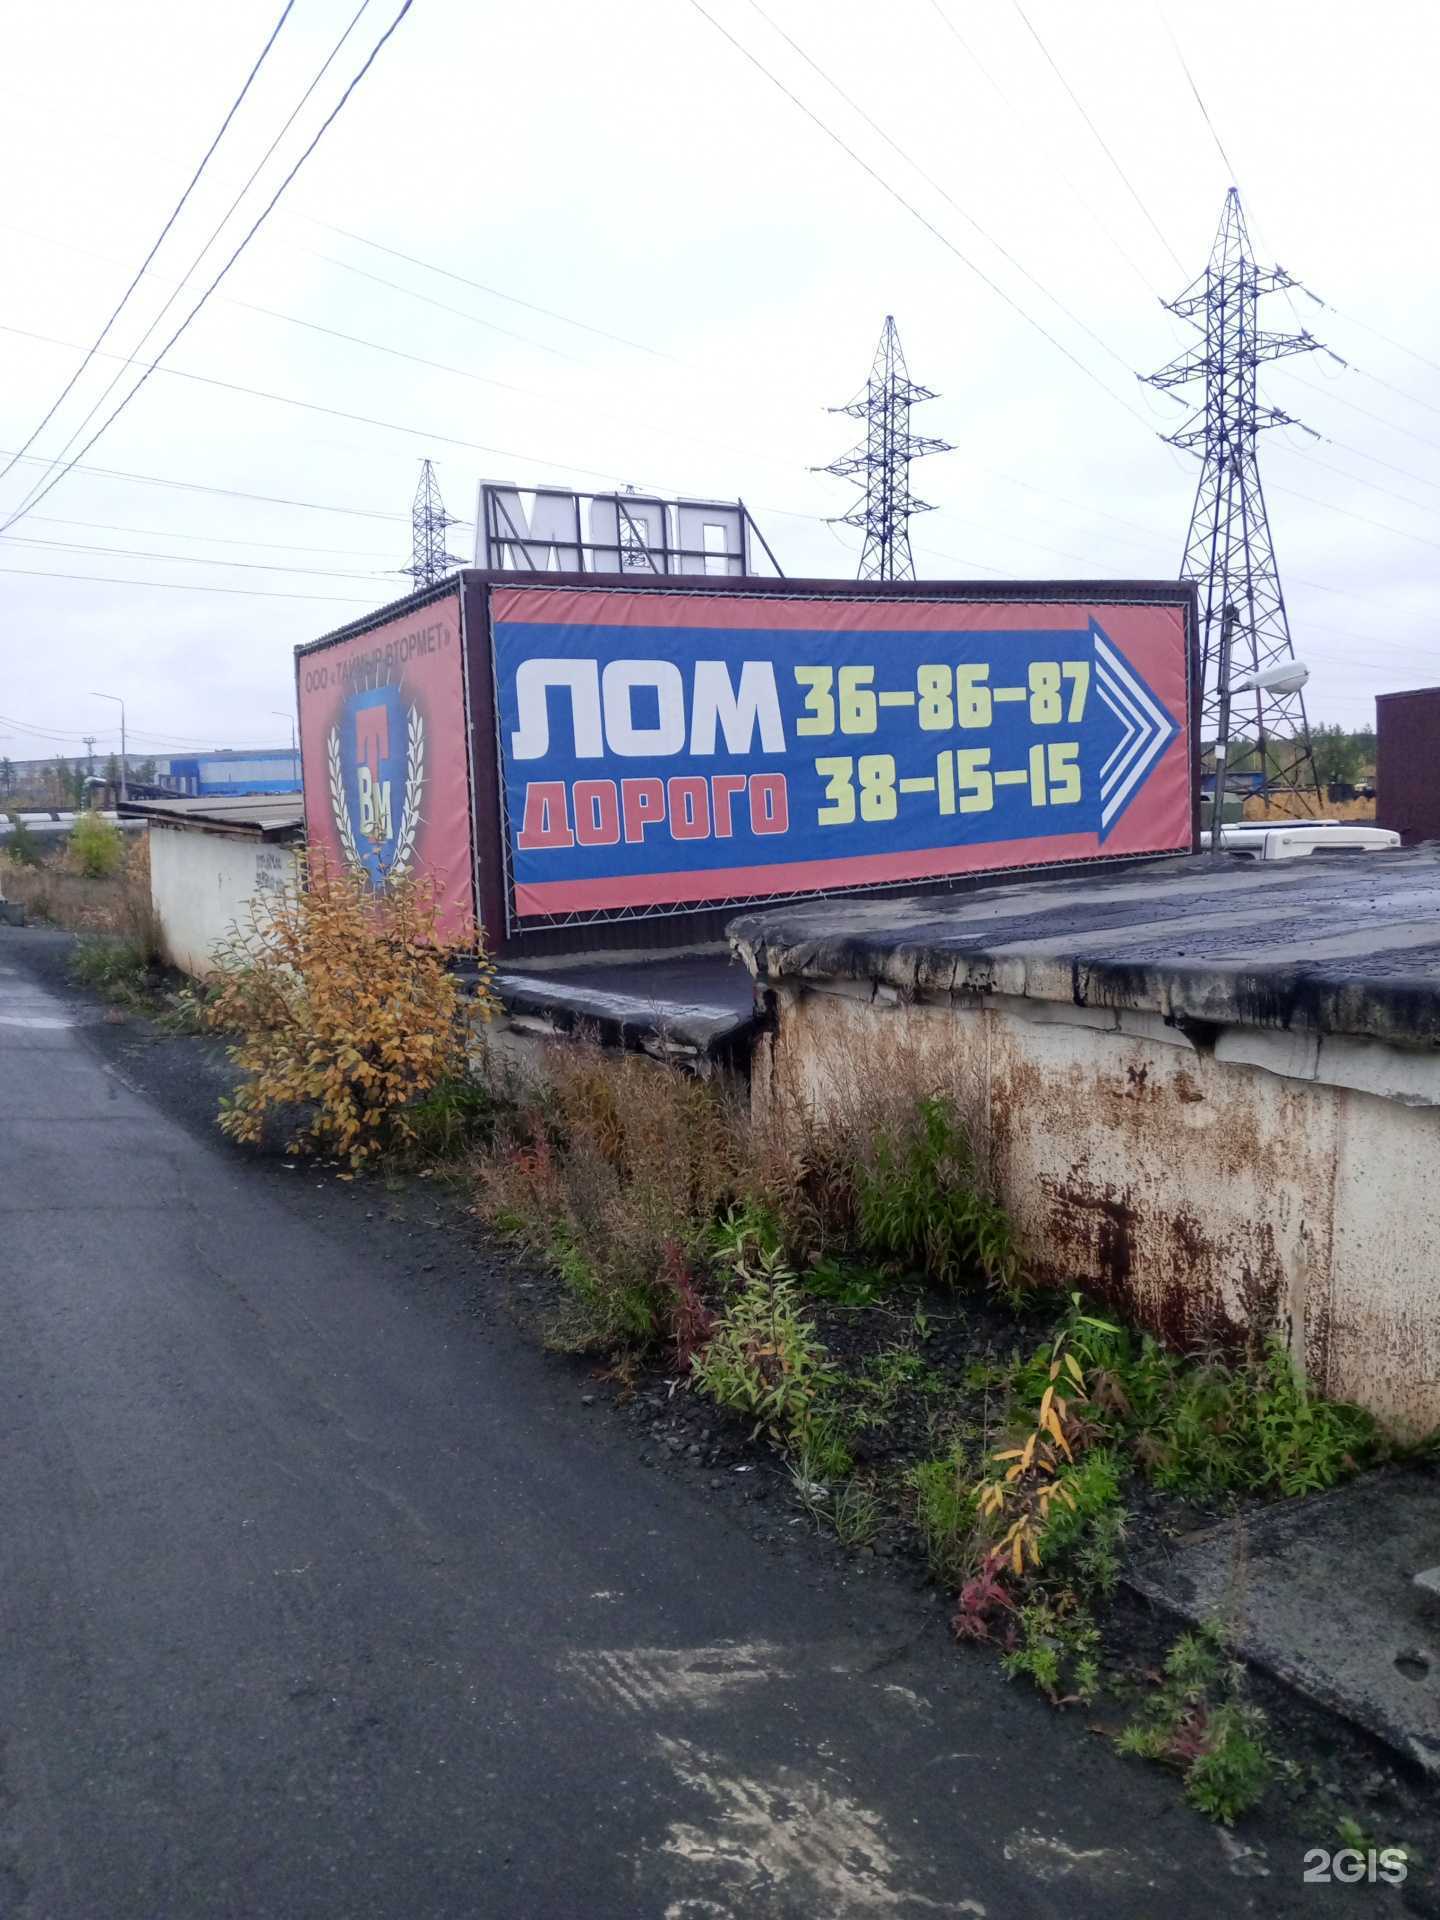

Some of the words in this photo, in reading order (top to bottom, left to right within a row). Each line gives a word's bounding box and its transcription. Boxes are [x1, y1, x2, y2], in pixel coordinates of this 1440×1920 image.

[305, 667, 328, 693] ООО
[511, 658, 787, 760] ЛОМ
[793, 661, 1091, 737] 36-86-87
[516, 772, 790, 850] ДОРОГО
[814, 742, 1082, 827] 38-15-15
